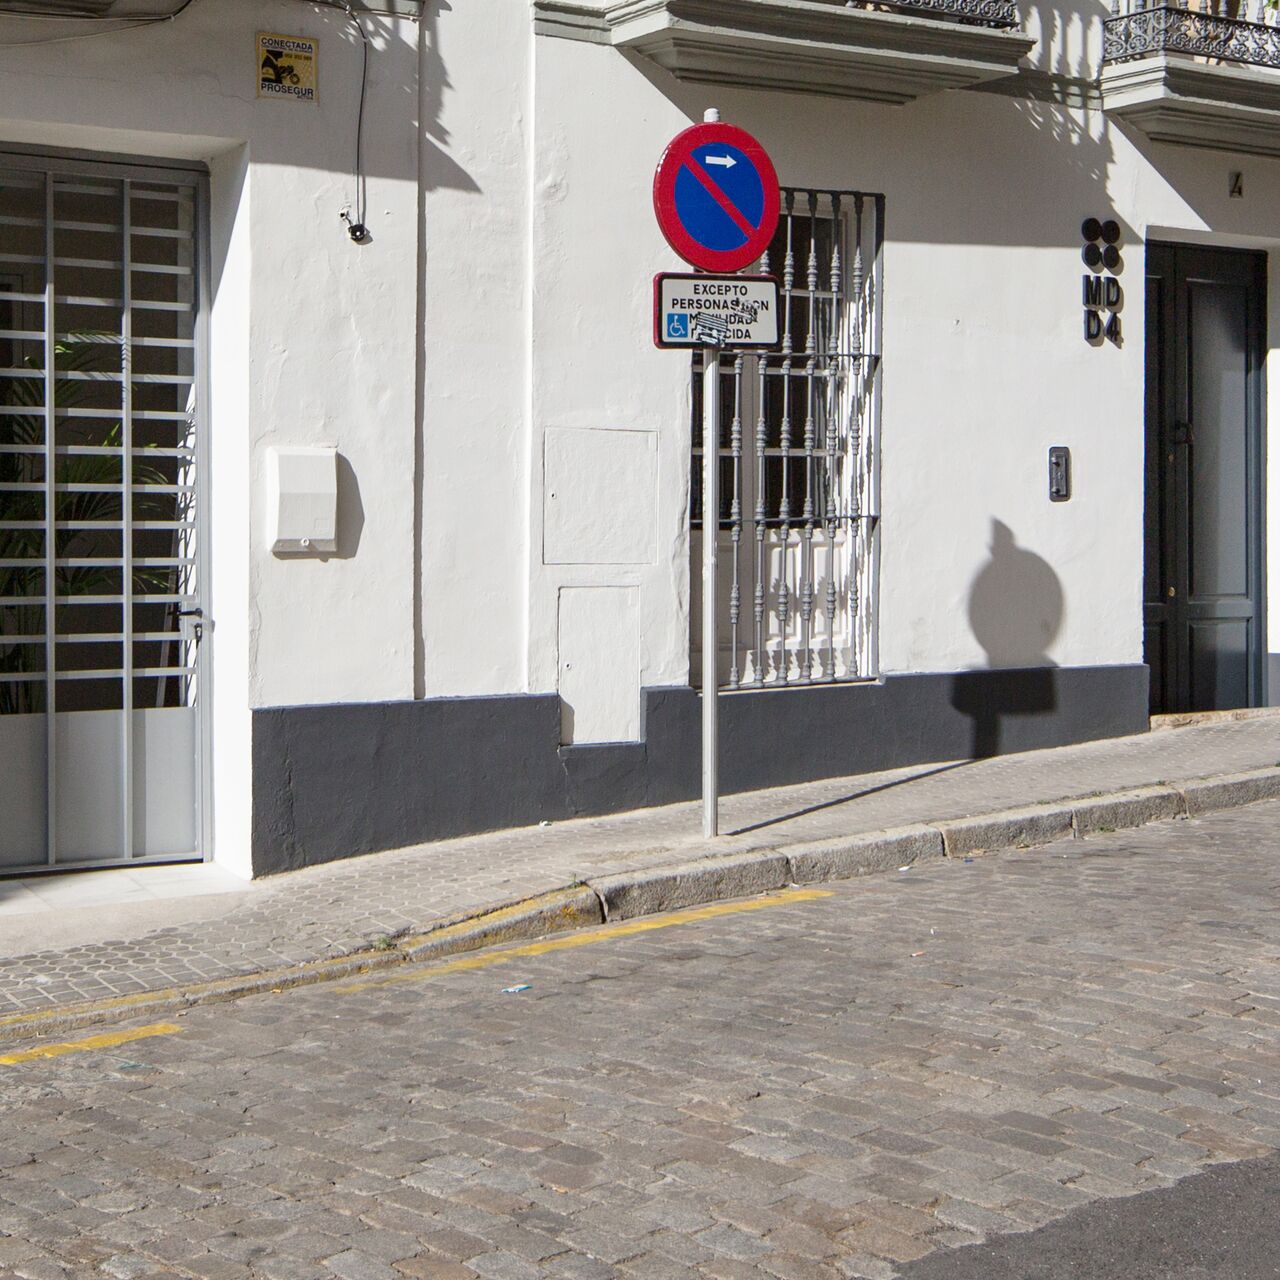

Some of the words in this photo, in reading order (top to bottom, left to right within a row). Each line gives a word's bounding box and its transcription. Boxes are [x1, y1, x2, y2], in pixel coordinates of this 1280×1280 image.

[261, 37, 313, 53] CONECTADA
[261, 83, 313, 96] PROSEGUR
[693, 284, 748, 296] EXCEPTO
